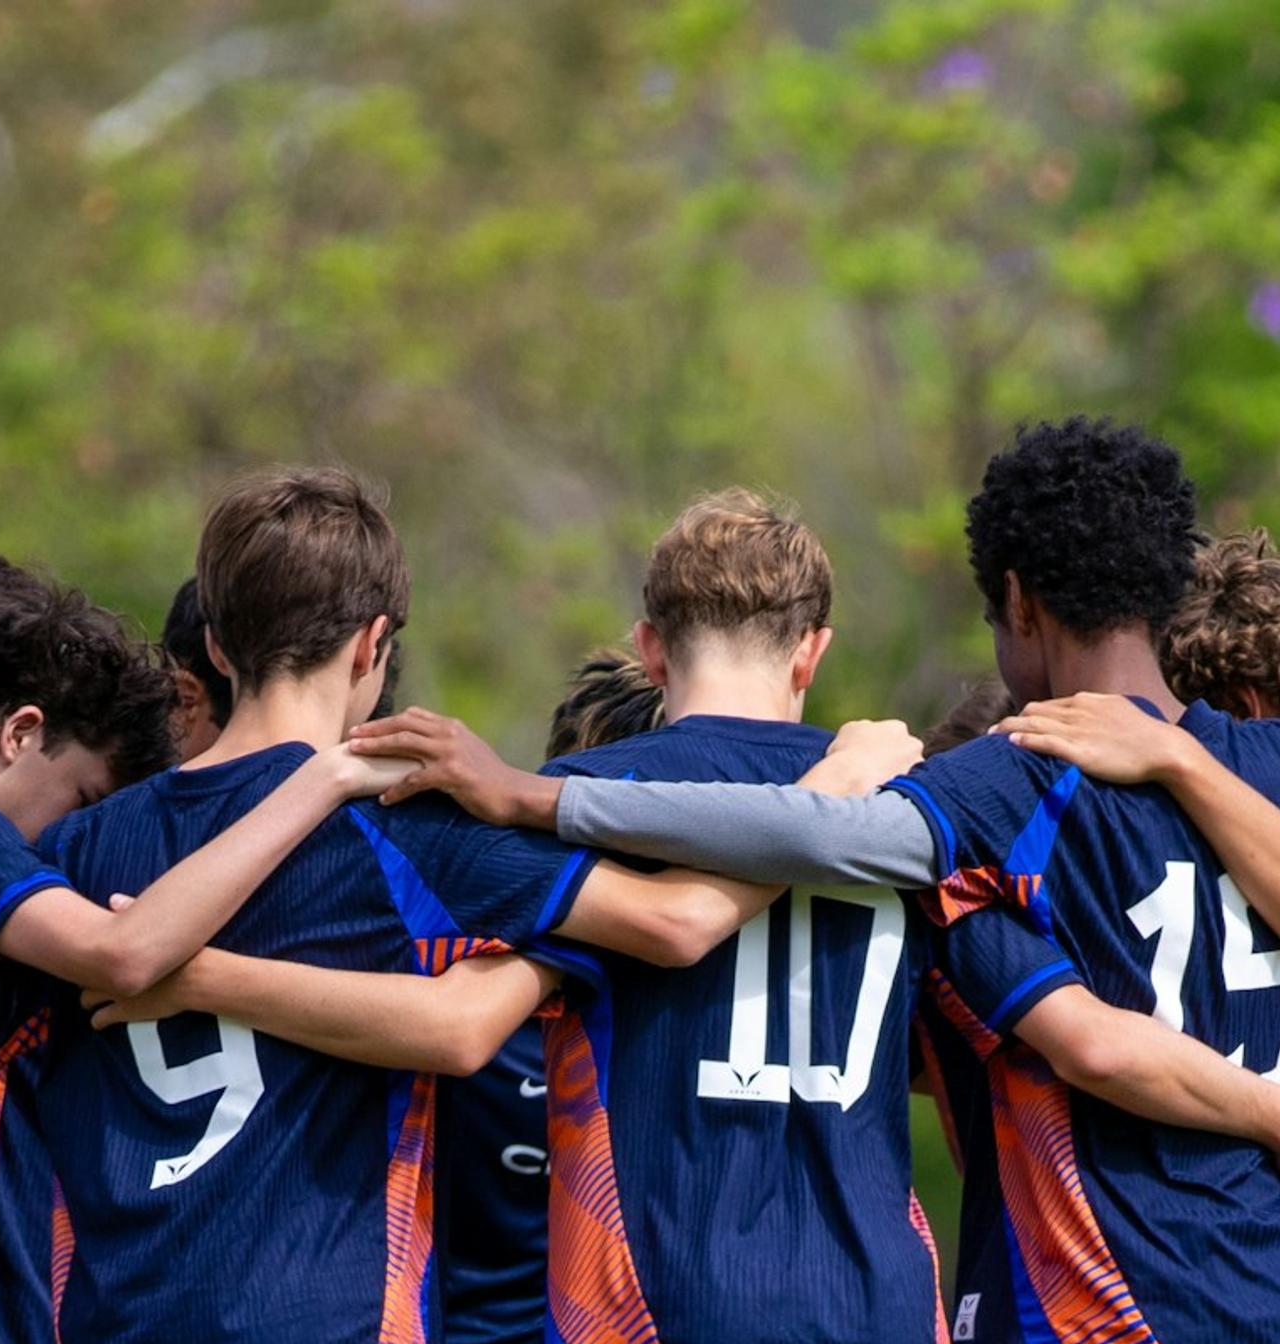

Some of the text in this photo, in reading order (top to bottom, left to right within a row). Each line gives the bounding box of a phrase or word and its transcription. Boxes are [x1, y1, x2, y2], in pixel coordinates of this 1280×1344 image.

[697, 884, 906, 1112] 10
[127, 1014, 265, 1190] 9
[501, 1144, 550, 1174] C
